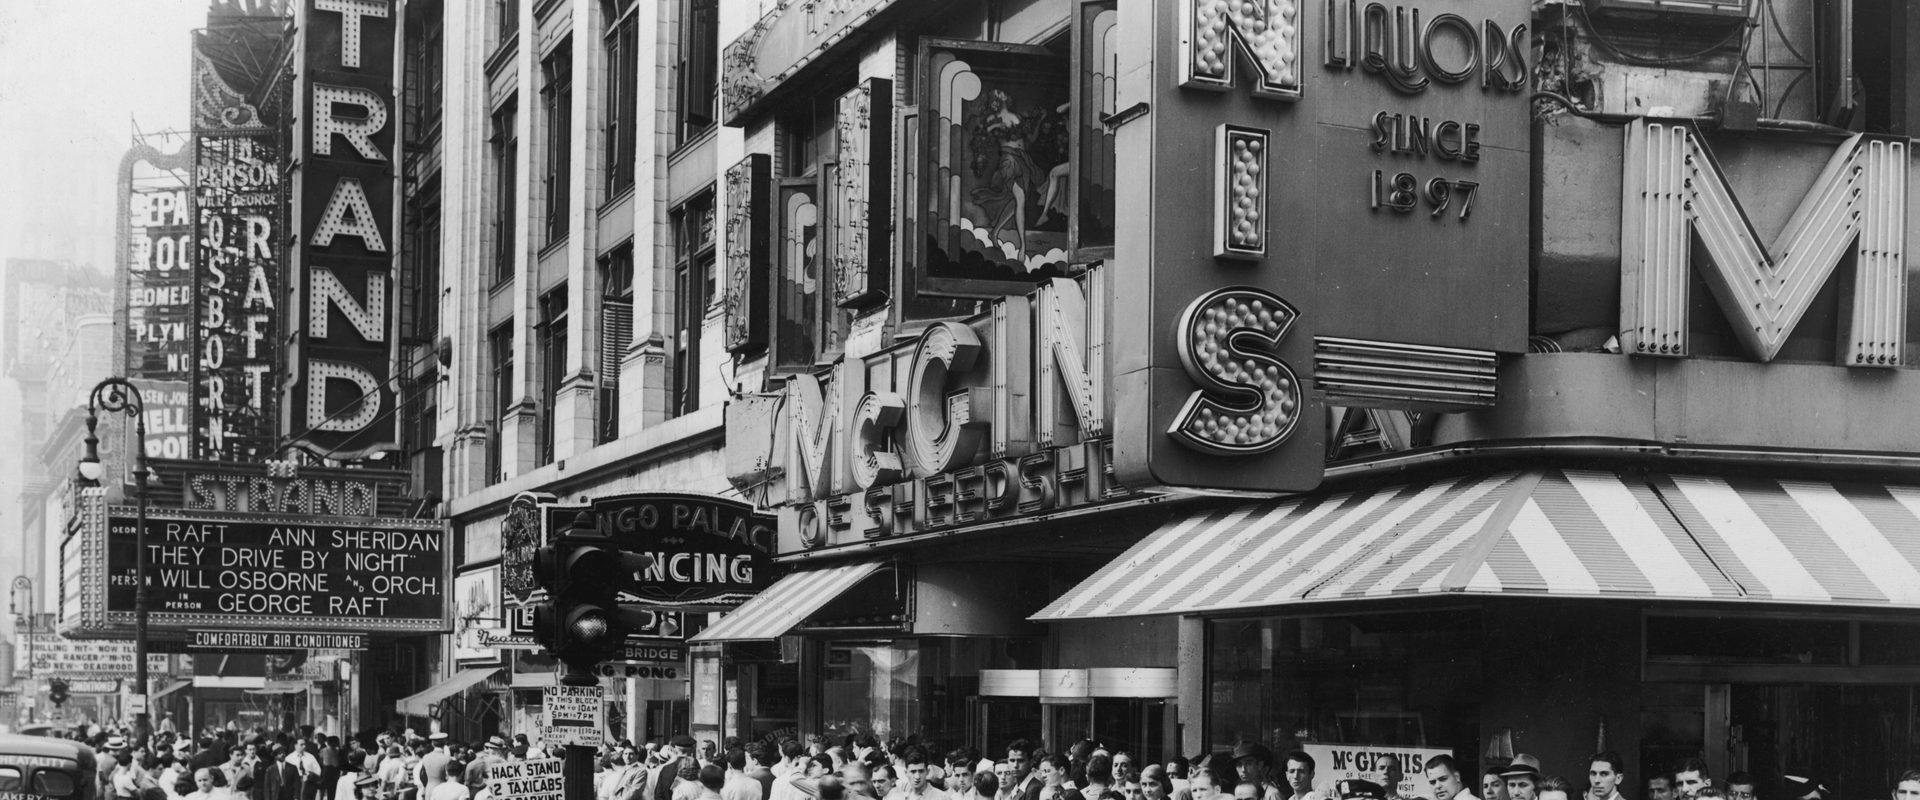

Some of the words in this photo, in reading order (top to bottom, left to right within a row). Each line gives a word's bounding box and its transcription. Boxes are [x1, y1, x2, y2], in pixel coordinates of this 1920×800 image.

[1324, 0, 1529, 93] LIQUORS
[1371, 110, 1480, 163] SINCE
[196, 163, 279, 188] PERSON
[196, 194, 224, 207] WILL
[231, 193, 278, 207] GEORGE
[1371, 169, 1480, 219] 1897
[242, 215, 275, 410] RAFT
[136, 322, 190, 342] PLYM
[206, 215, 225, 458] OSBORN
[1325, 406, 1424, 461] AY
[189, 473, 372, 516] STRAND
[596, 504, 659, 538] NGO
[799, 494, 851, 549] OF
[112, 526, 149, 535] GEORE
[166, 523, 229, 544] RAFT
[268, 527, 316, 547] ANN
[331, 529, 440, 552] SHERIDAN
[147, 544, 205, 566] THEY
[221, 547, 285, 569] DRIVE
[301, 550, 330, 570] BY
[111, 575, 152, 586] PERSN
[160, 568, 211, 589] WILL
[219, 570, 330, 592] OSBORNE
[371, 575, 440, 596] ORCH.
[126, 568, 137, 576] IN
[165, 601, 202, 609] PERSON
[218, 592, 313, 614] GEORGE
[329, 595, 389, 616] RAFT
[178, 592, 188, 600] IN
[196, 631, 268, 648] COMFORTABLY
[273, 633, 291, 647] AIR
[295, 634, 362, 649] CONDITIONED
[625, 648, 679, 660] BRIDGE
[625, 665, 677, 679] PONG
[544, 687, 558, 696] NO
[561, 687, 602, 697] PARKING
[548, 703, 566, 711] 7AM
[552, 711, 569, 719] 5PM
[492, 765, 522, 779] HACK
[526, 761, 561, 777] STAND
[493, 783, 502, 796] 2
[507, 778, 562, 795] TAXICABS
